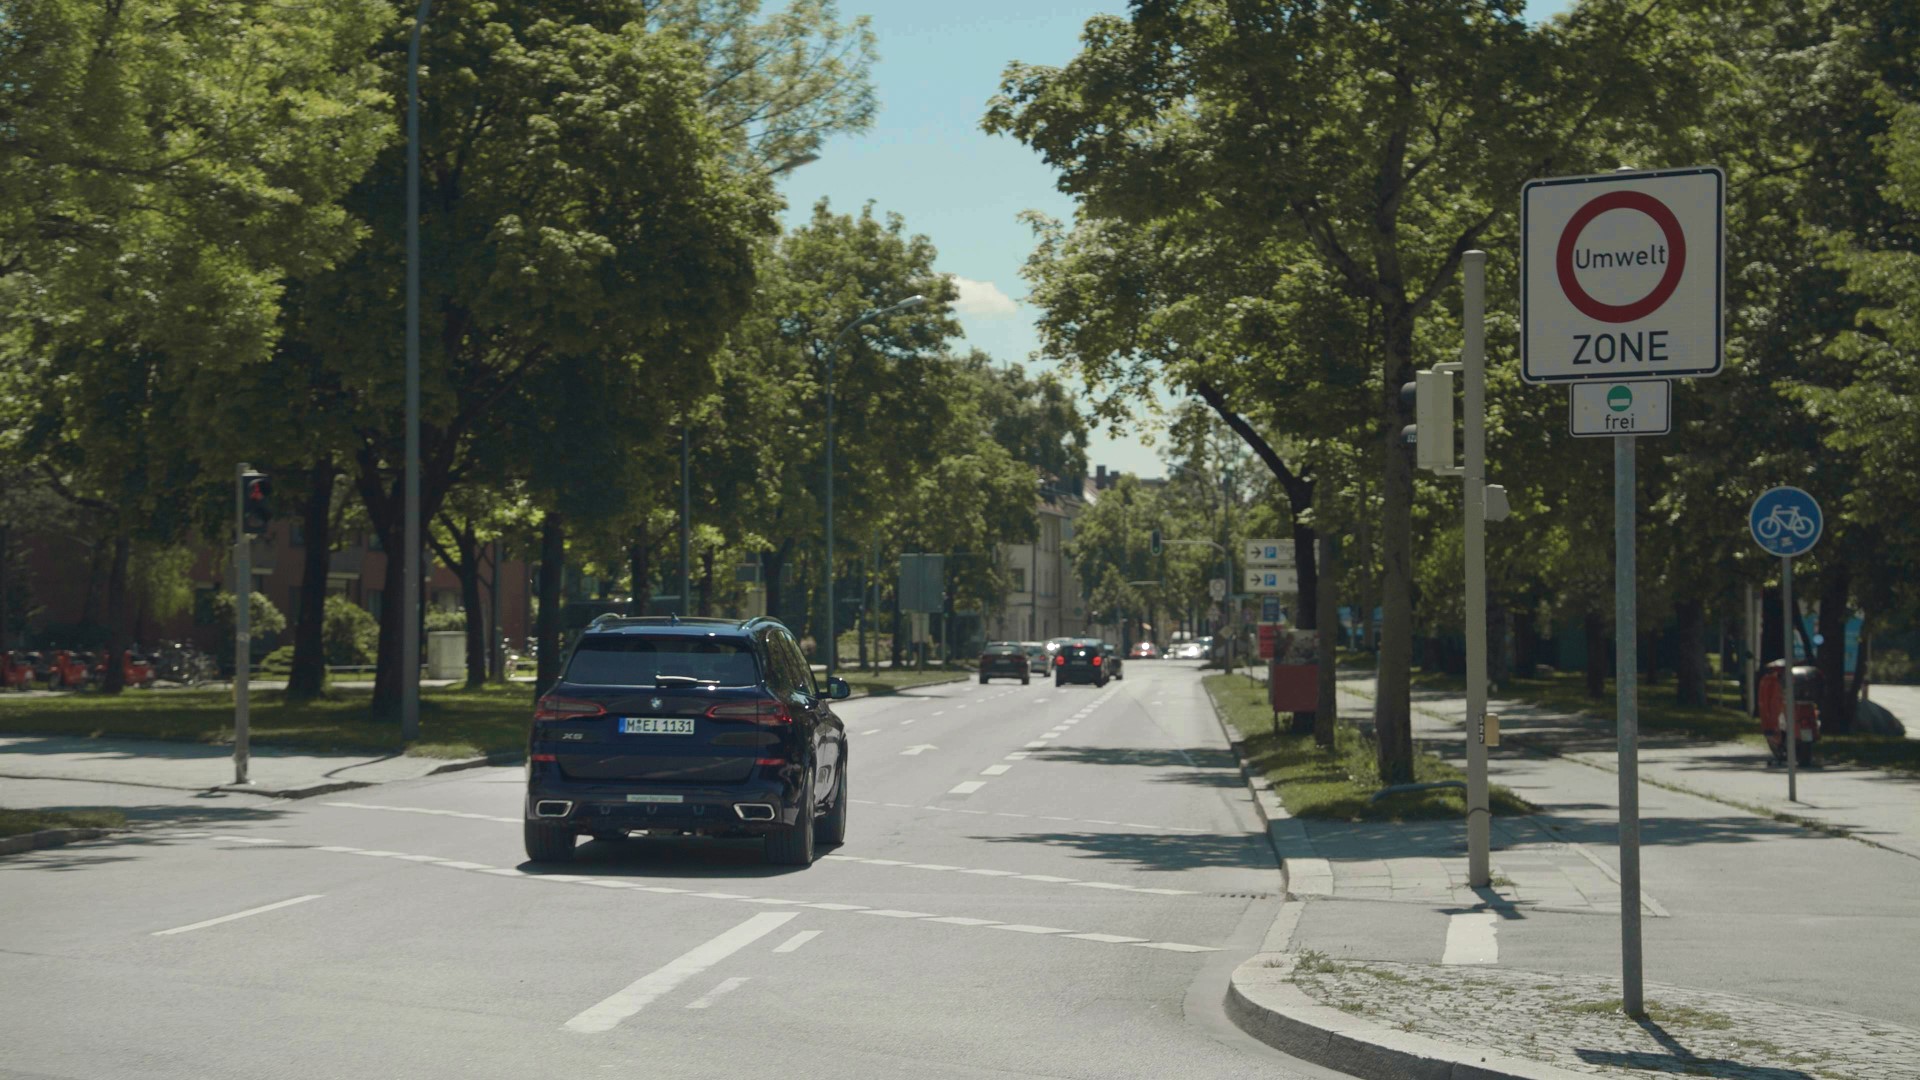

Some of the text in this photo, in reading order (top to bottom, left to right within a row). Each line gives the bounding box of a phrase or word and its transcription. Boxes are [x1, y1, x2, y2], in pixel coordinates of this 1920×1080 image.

[1575, 244, 1666, 269] Umwelt
[1572, 330, 1669, 365] ZONE
[1605, 413, 1635, 430] frei
[662, 720, 693, 733] 1131
